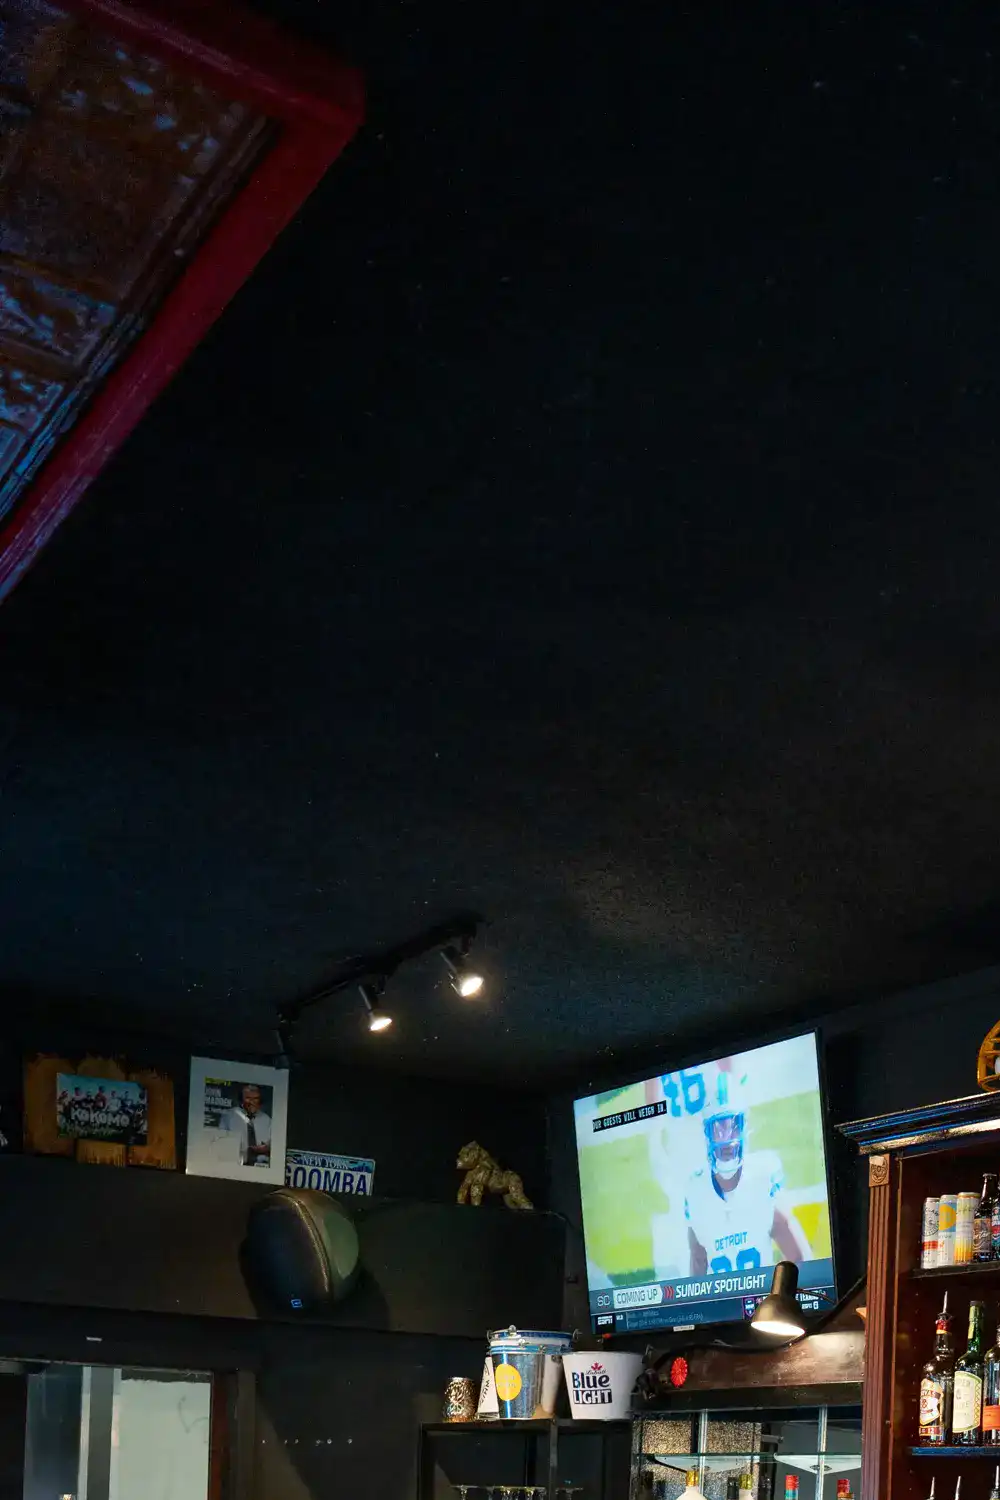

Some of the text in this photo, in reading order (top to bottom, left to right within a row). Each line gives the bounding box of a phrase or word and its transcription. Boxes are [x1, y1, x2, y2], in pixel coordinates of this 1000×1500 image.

[71, 1108, 130, 1127] KOKOMO
[302, 1155, 348, 1170] NEW YORK
[715, 1232, 748, 1251] DETROIT
[676, 1274, 766, 1299] SUNDAY SPOTLIGHT
[616, 1287, 658, 1305] COMING UP
[597, 1316, 613, 1326] ESPN
[572, 1372, 610, 1388] Blue
[573, 1389, 612, 1404] LIGHT
